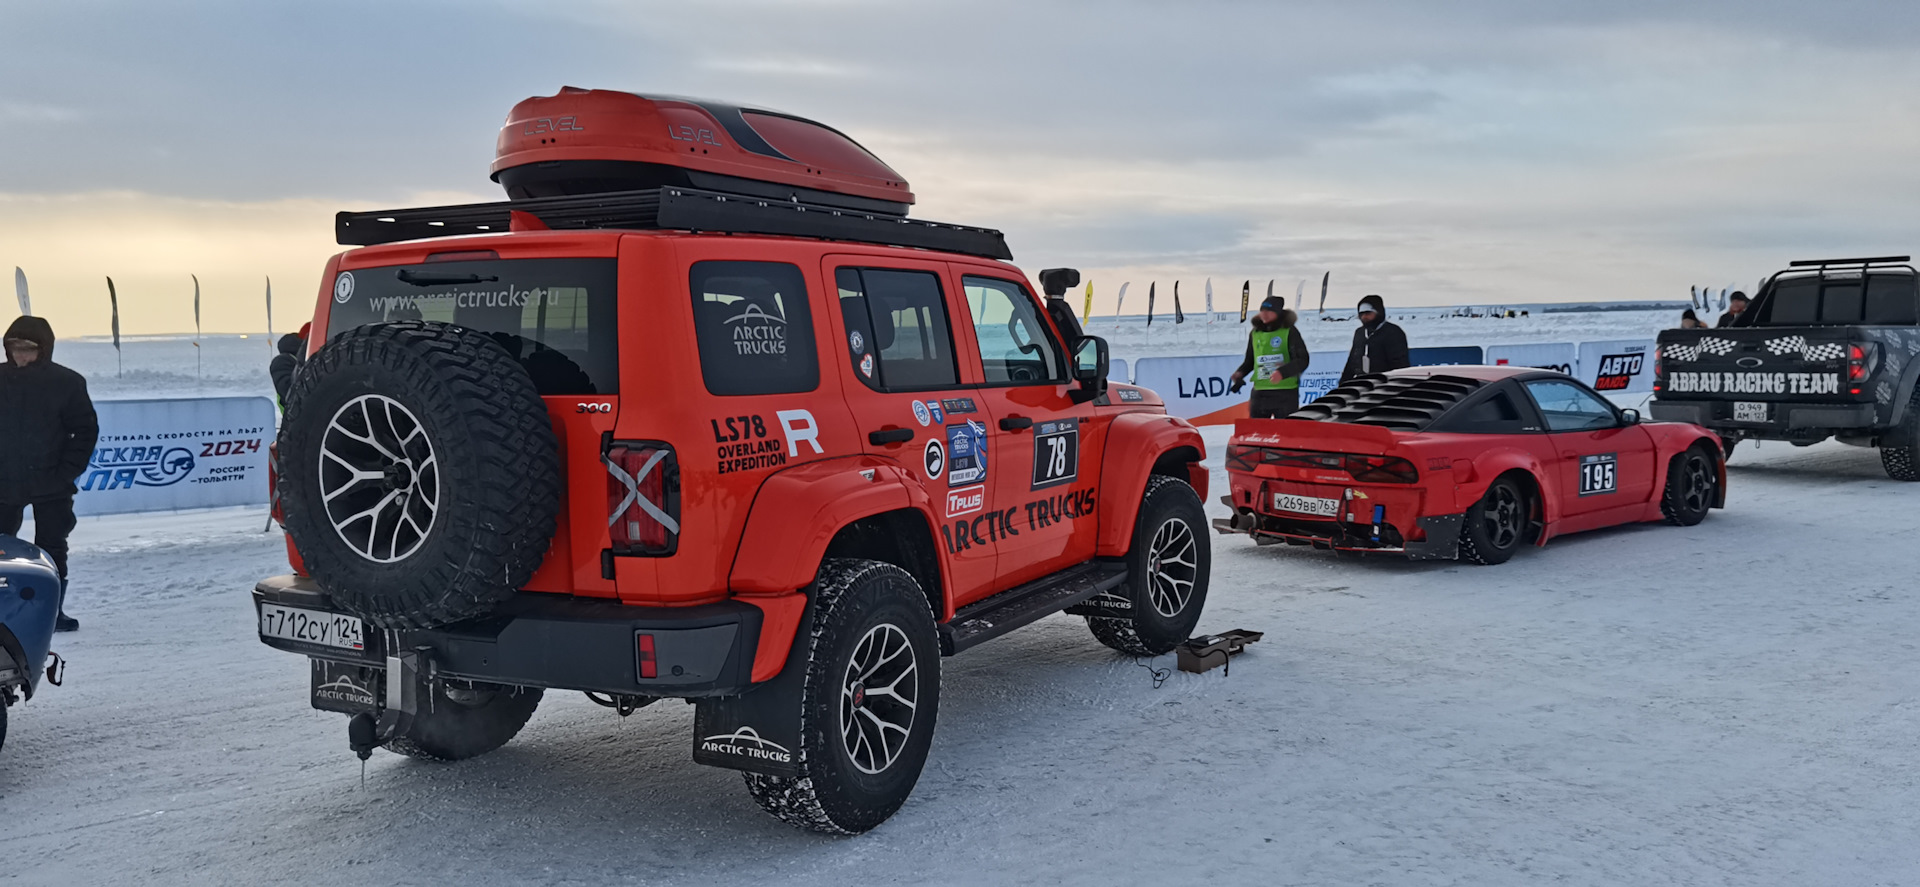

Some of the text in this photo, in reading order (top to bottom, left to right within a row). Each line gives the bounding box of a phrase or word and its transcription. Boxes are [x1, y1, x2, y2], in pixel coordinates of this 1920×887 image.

[525, 116, 583, 135] LEVEL
[669, 124, 722, 146] LEVEL
[369, 284, 559, 312] www.arctictrucks.ru
[733, 326, 783, 340] ARCTIC
[734, 340, 786, 355] TRUCKS
[1599, 355, 1641, 376] АВТО
[1595, 376, 1629, 389] ПЛЮС
[1668, 371, 1838, 394] ABRAU RACING TEAM
[576, 402, 612, 414] 300
[101, 426, 264, 442] СТИВАЛЬ СКОРОСТИ НА ЛЬДУ
[711, 414, 766, 443] LS78
[776, 408, 824, 457] R
[200, 438, 262, 458] 2024
[717, 439, 780, 459] OVERLAND
[1046, 436, 1067, 478] 78
[210, 465, 245, 475] РОССИЯ
[718, 452, 786, 474] EXPEDITION
[81, 468, 138, 491] ЛЯ
[198, 474, 244, 484] ТОЛЬЯТТИ
[1583, 464, 1613, 490] 195
[949, 493, 982, 512] TPLUS
[1318, 499, 1336, 511] 763
[942, 487, 1095, 554] ARCTIC TRUCKS
[1100, 600, 1131, 609] TRUCKS
[334, 617, 359, 640] 124
[339, 638, 353, 647] RUS
[316, 690, 373, 705] ARCTIC TRUCKS
[701, 741, 791, 763] ARCTIC TRUCKS
